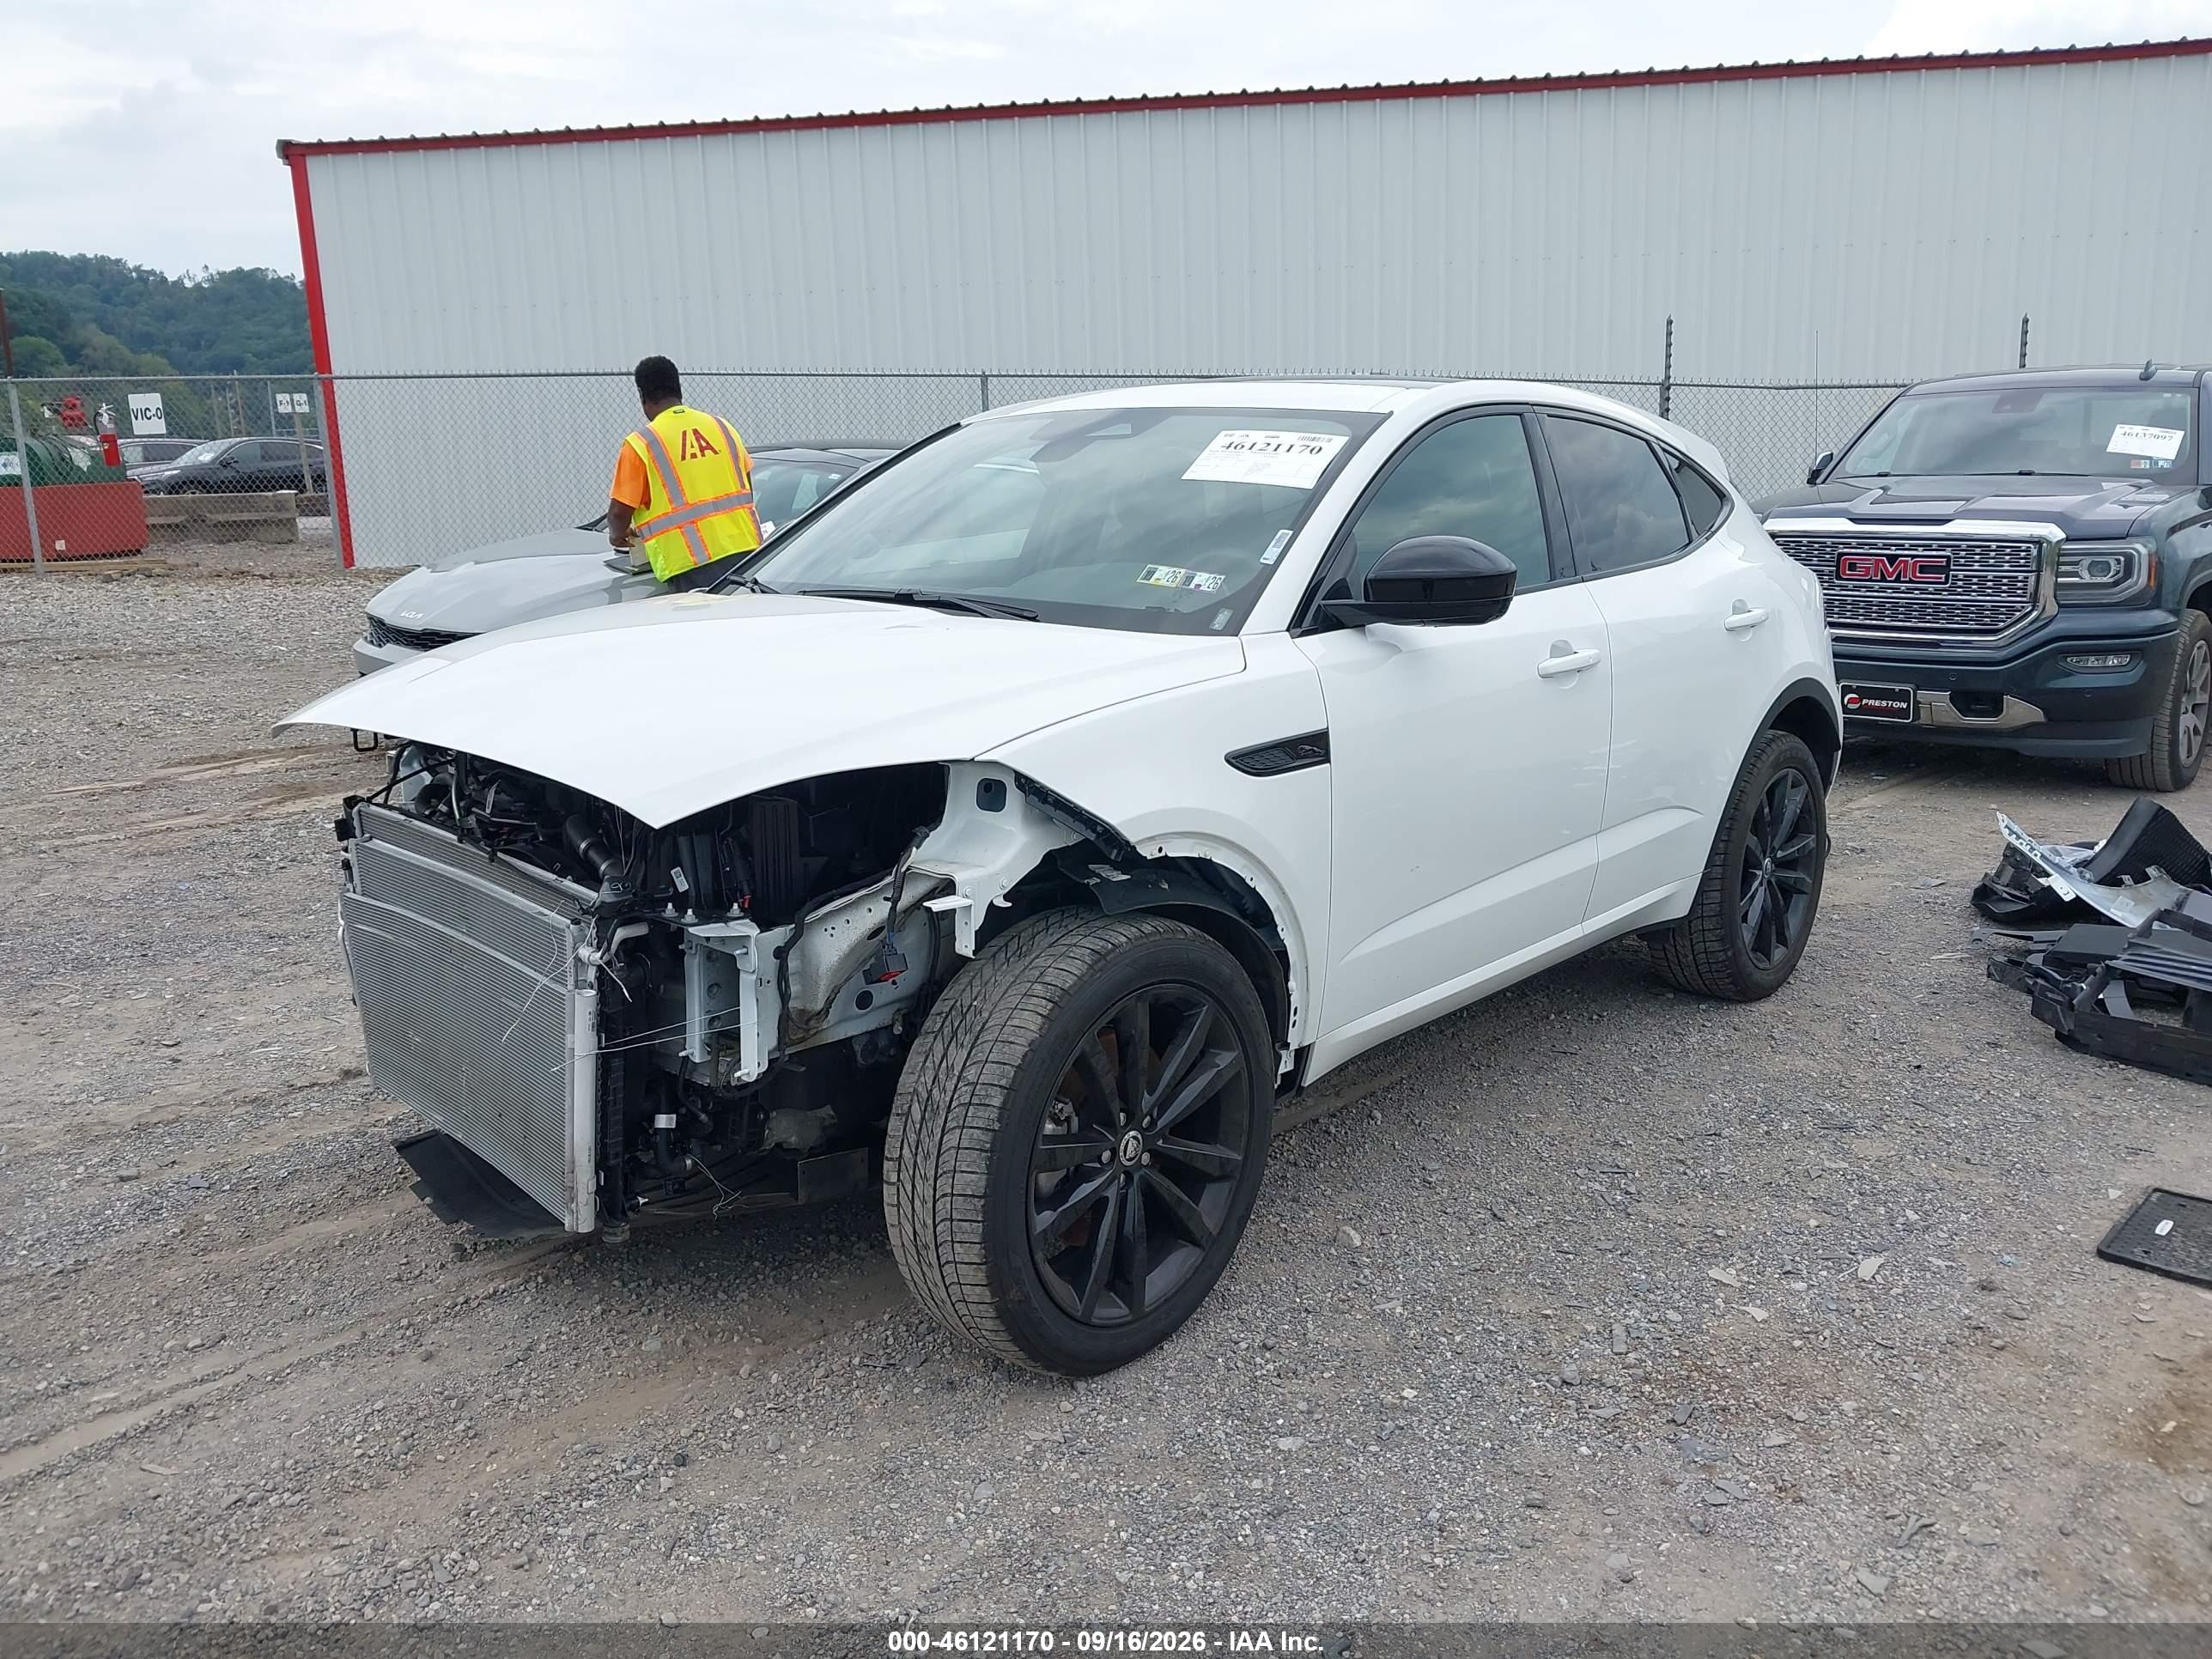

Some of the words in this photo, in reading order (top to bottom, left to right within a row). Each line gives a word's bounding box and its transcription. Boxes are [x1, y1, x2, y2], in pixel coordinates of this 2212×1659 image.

[1220, 441, 1323, 455] 46121170
[1839, 556, 1949, 581] GMC
[1862, 698, 1908, 709] PRESTON
